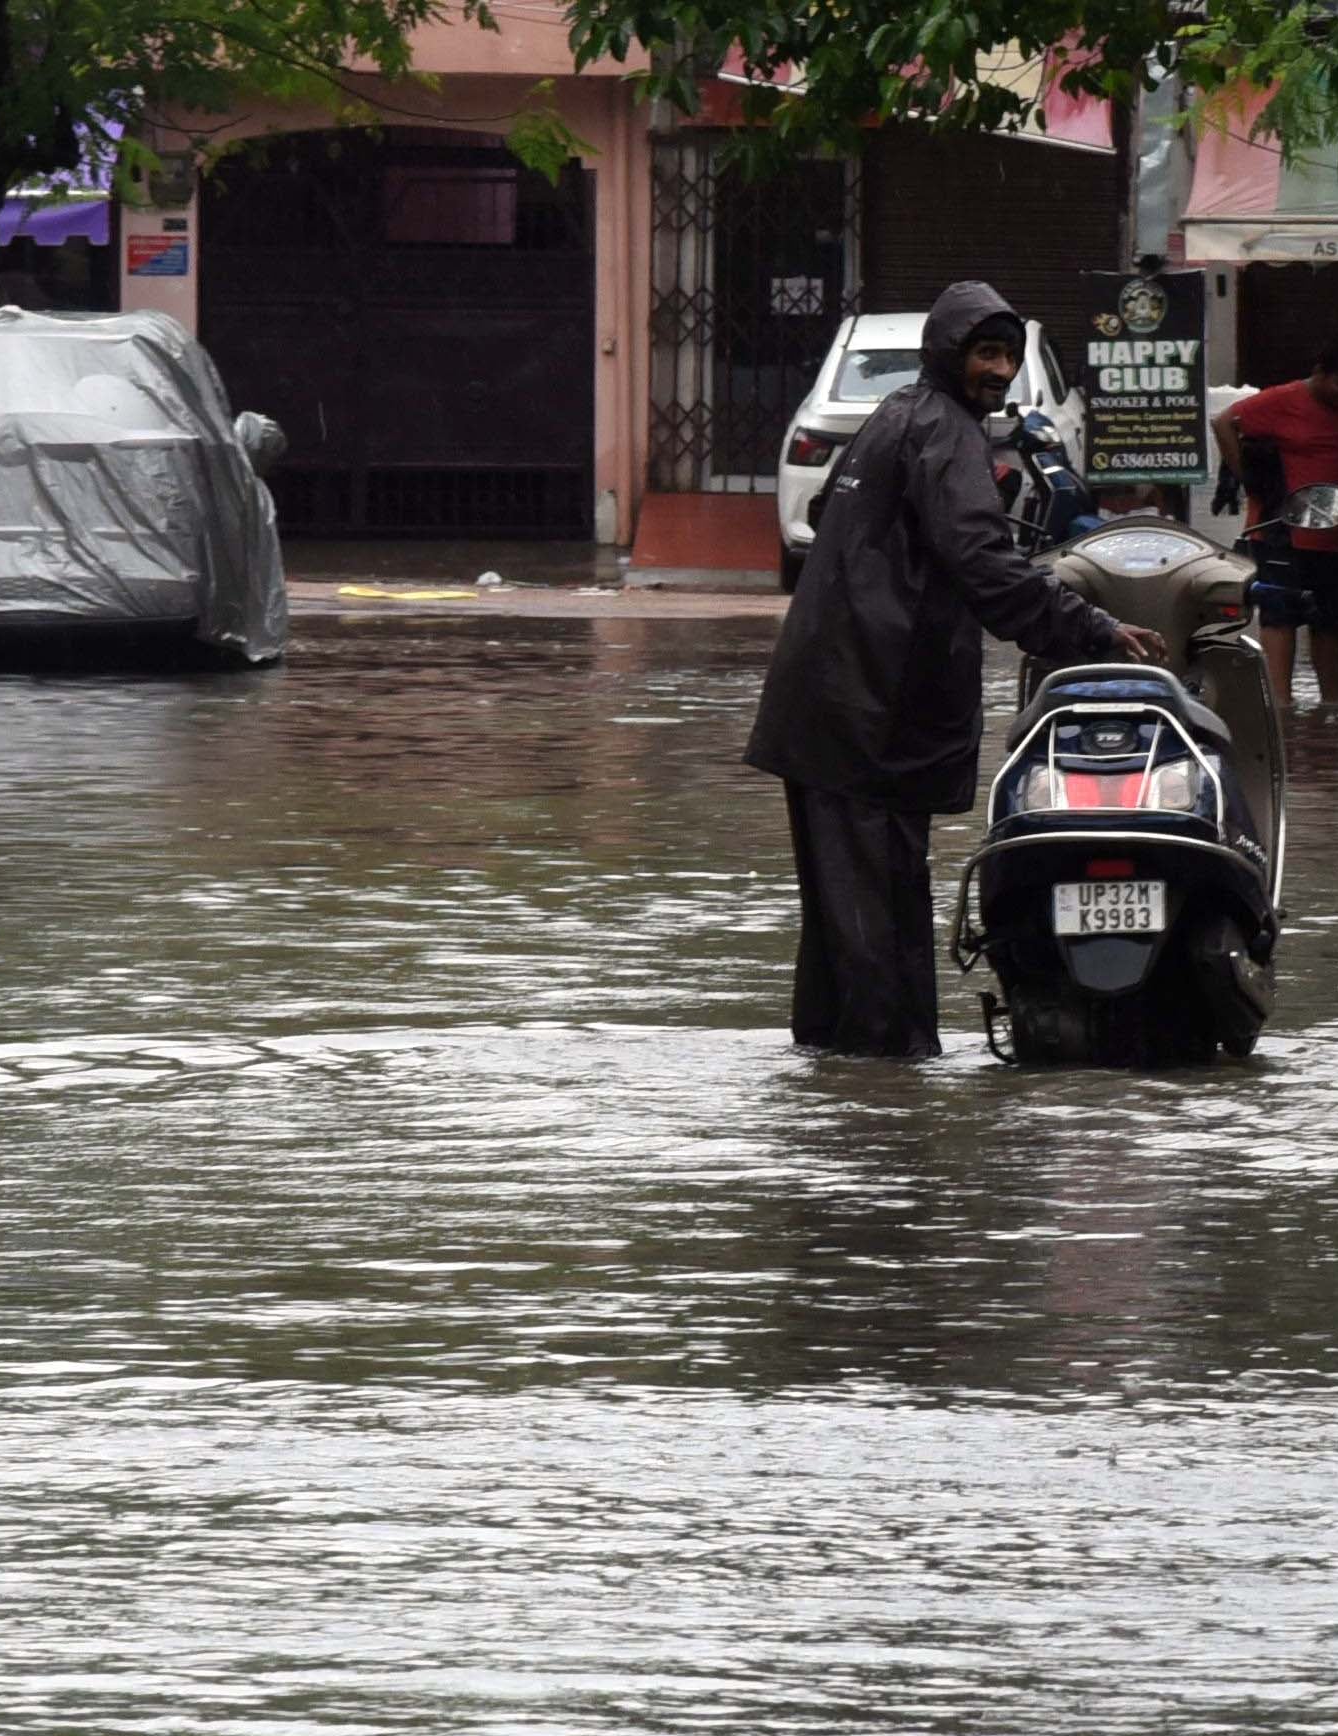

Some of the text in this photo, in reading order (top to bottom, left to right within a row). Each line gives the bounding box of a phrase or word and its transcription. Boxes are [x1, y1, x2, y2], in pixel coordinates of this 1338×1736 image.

[1313, 242, 1337, 257] AS
[1087, 340, 1201, 366] HAPPY
[1099, 366, 1190, 392] CLUB
[1090, 395, 1199, 409] SNOOKER & POOL
[1111, 452, 1199, 468] 6386035810
[1078, 883, 1150, 906] UP32M
[1079, 907, 1151, 931] K9983
